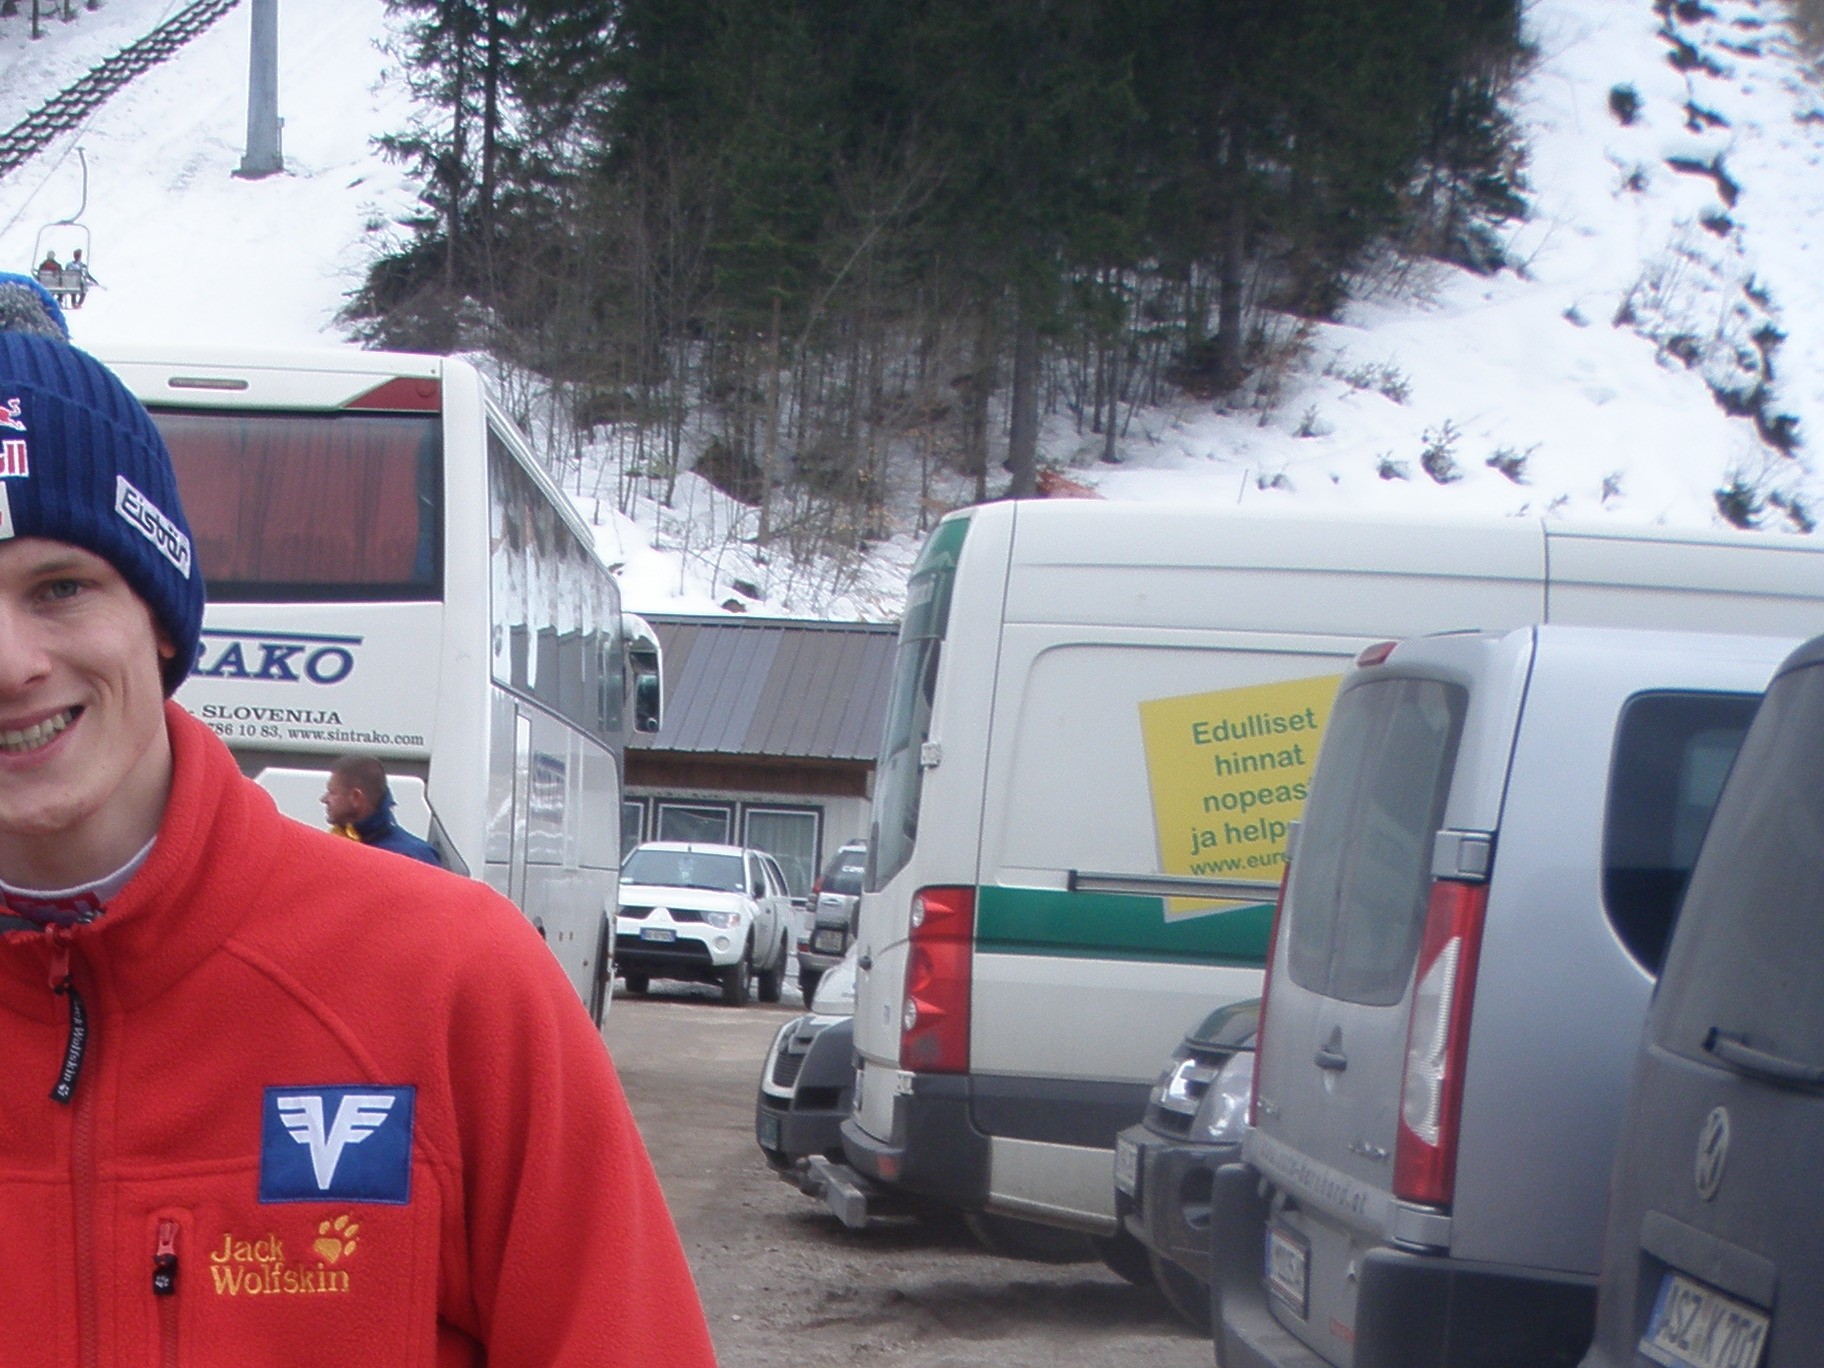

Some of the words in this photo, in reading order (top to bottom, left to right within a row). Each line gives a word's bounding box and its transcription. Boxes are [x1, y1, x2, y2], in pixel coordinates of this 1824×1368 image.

[121, 487, 189, 562] Eisbär
[202, 705, 343, 725] SLOVENIJA
[1191, 707, 1318, 745] Edulliset
[239, 724, 257, 737] 10
[288, 727, 424, 747] www.sintrako.com
[1215, 744, 1306, 776] hinnat
[1203, 777, 1310, 814] nopeas
[1190, 826, 1218, 856] ja
[1224, 818, 1287, 844] help
[211, 1233, 285, 1263] Jack
[210, 1263, 350, 1296] Wolfskin
